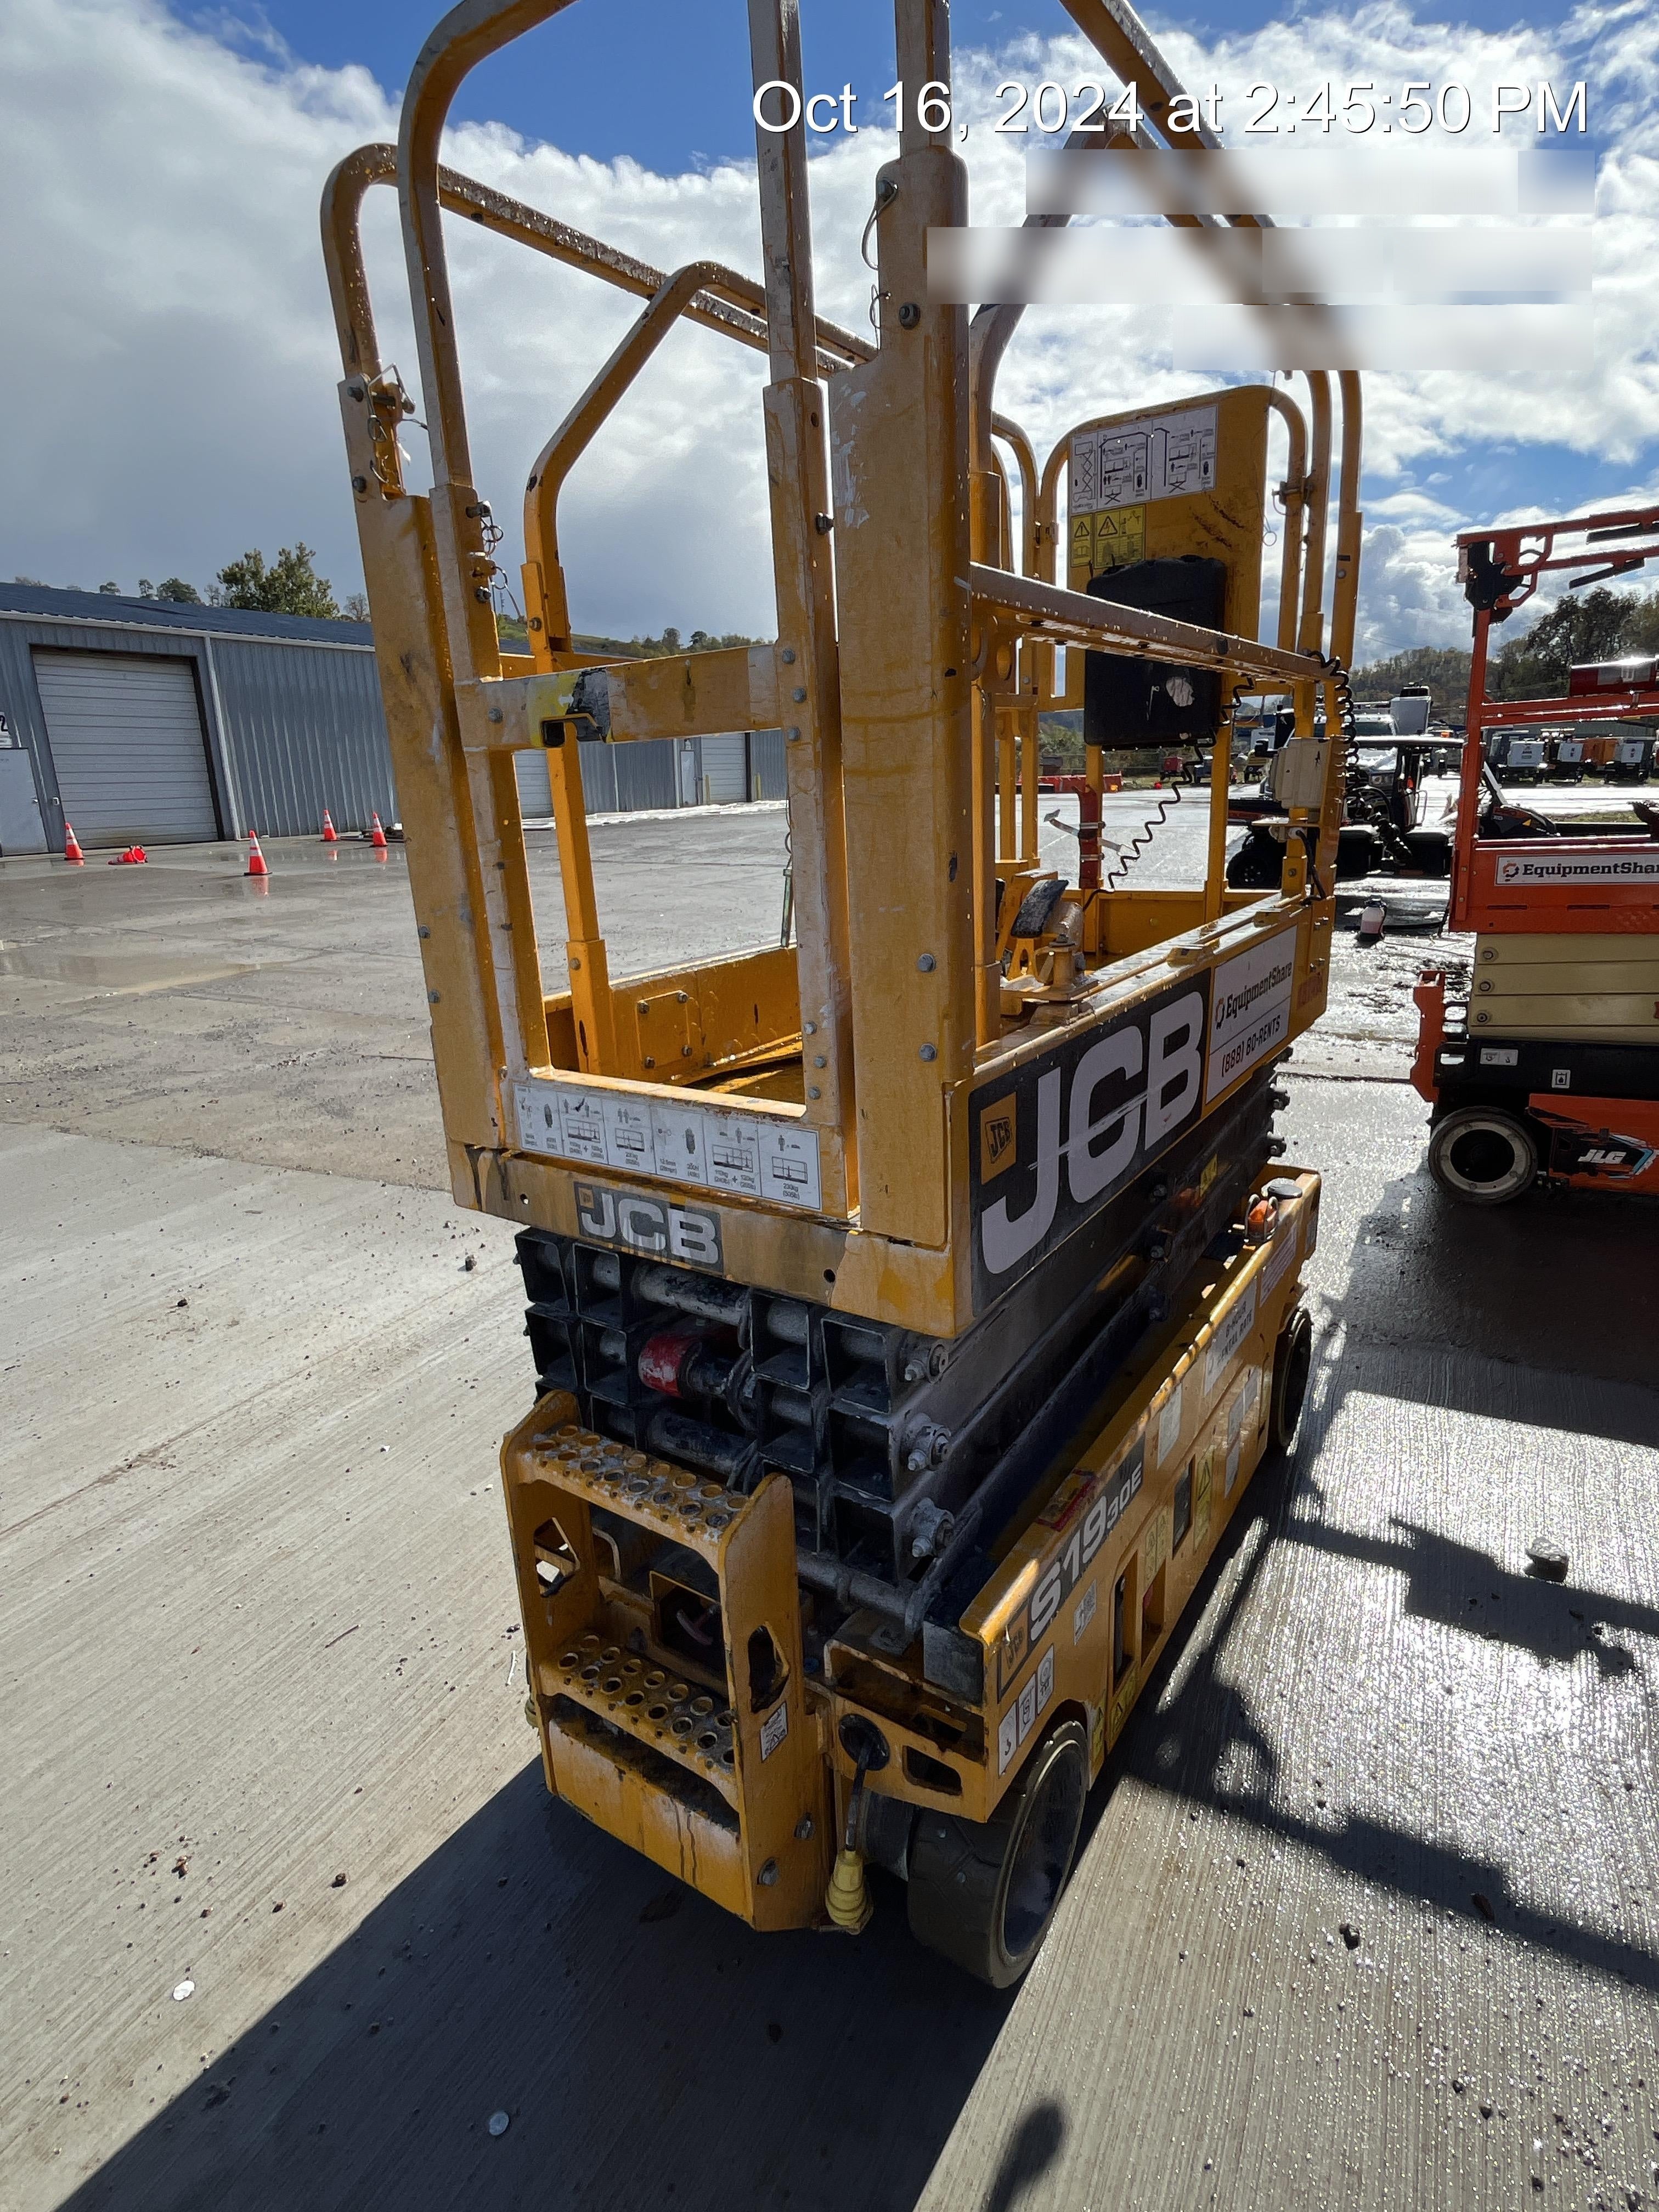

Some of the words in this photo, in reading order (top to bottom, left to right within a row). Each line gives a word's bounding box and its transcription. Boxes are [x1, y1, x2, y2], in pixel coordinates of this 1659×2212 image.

[1226, 962, 1292, 1019] EquipmentShare
[1221, 1041, 1244, 1077] (888)
[1246, 1015, 1281, 1057] 80-RENTS
[982, 991, 1203, 1274] JCB
[990, 1120, 1011, 1158] JCB
[1577, 1149, 1627, 1164] JLG
[582, 1192, 719, 1264] JCB
